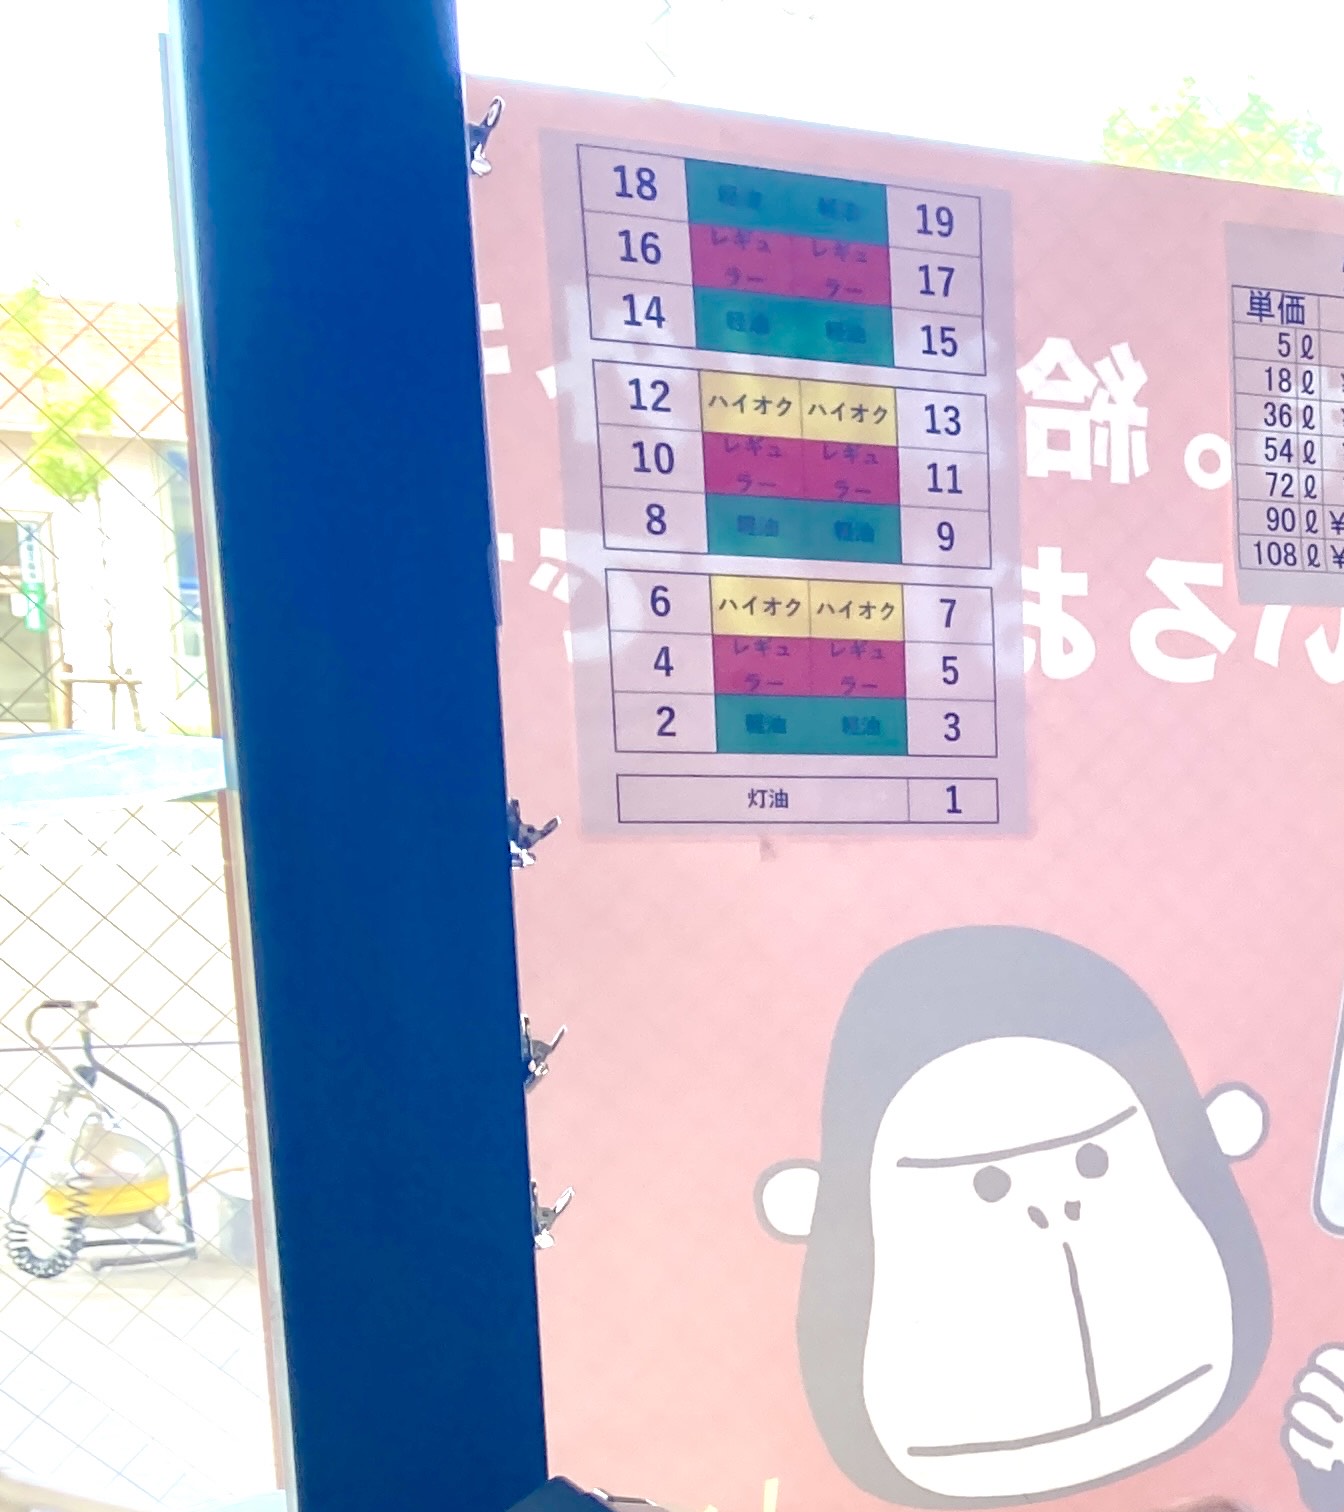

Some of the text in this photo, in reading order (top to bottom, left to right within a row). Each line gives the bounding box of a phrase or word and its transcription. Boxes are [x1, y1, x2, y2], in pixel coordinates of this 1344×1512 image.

[612, 164, 954, 237] 18 19
[617, 230, 662, 264] 16
[918, 265, 955, 297] 17
[622, 293, 666, 329] 14
[920, 325, 958, 357] 15
[1246, 291, 1306, 326] 単価
[1277, 334, 1292, 357] 5
[1264, 367, 1292, 392] 18
[628, 378, 961, 437] 12 ハイオク ハイオク 13
[1263, 403, 1293, 428] 36
[632, 441, 675, 474] 10
[926, 463, 963, 495] 11
[1264, 438, 1293, 463] 54
[1265, 473, 1295, 498] 72
[645, 503, 667, 535] 8
[936, 522, 955, 553] 9
[1266, 508, 1296, 533] 90
[1253, 541, 1297, 567] 108
[650, 585, 957, 629] 6 ハイオク ハイオク 7
[653, 646, 674, 677] 4
[942, 654, 959, 685] 5
[745, 673, 878, 695] ラー ラー
[656, 706, 677, 738] 2
[943, 712, 961, 741] 3
[748, 786, 962, 814] 灯油 1
